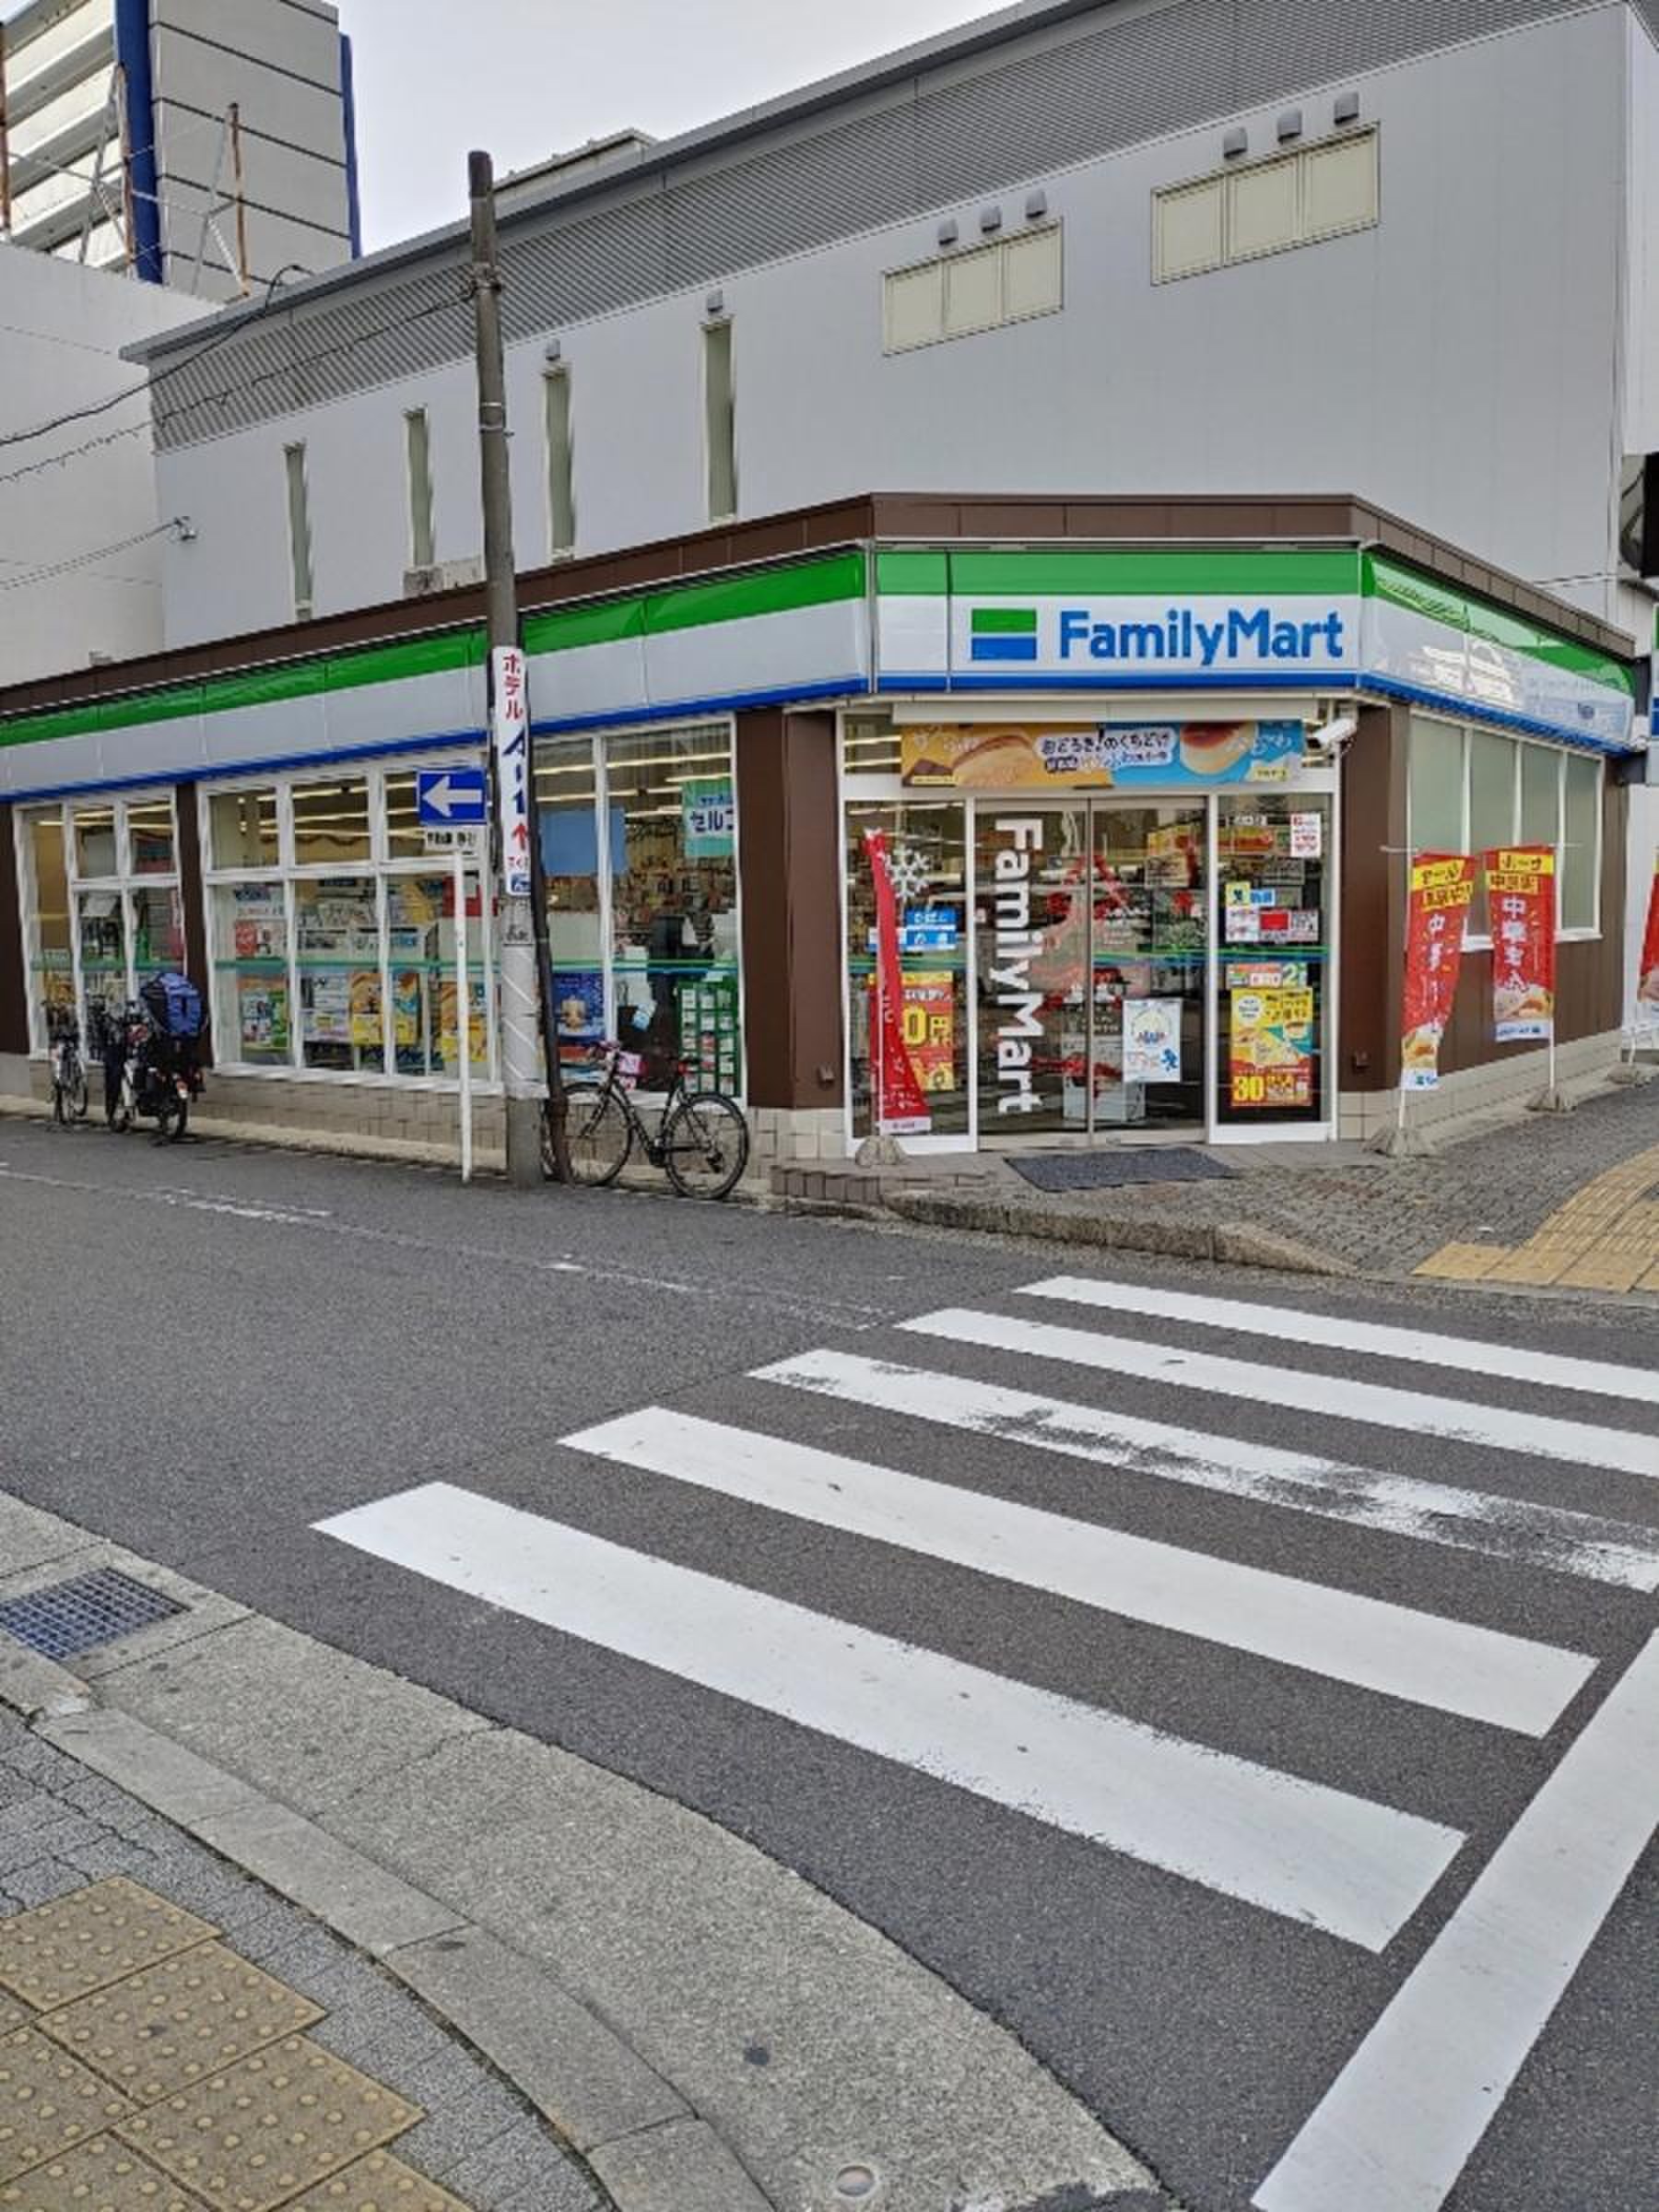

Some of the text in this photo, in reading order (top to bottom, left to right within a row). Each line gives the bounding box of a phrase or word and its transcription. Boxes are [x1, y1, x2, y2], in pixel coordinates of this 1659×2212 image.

[1059, 608, 1344, 665] FamilyMart
[502, 653, 524, 721] ホテル
[989, 818, 1044, 1114] FamilyMart
